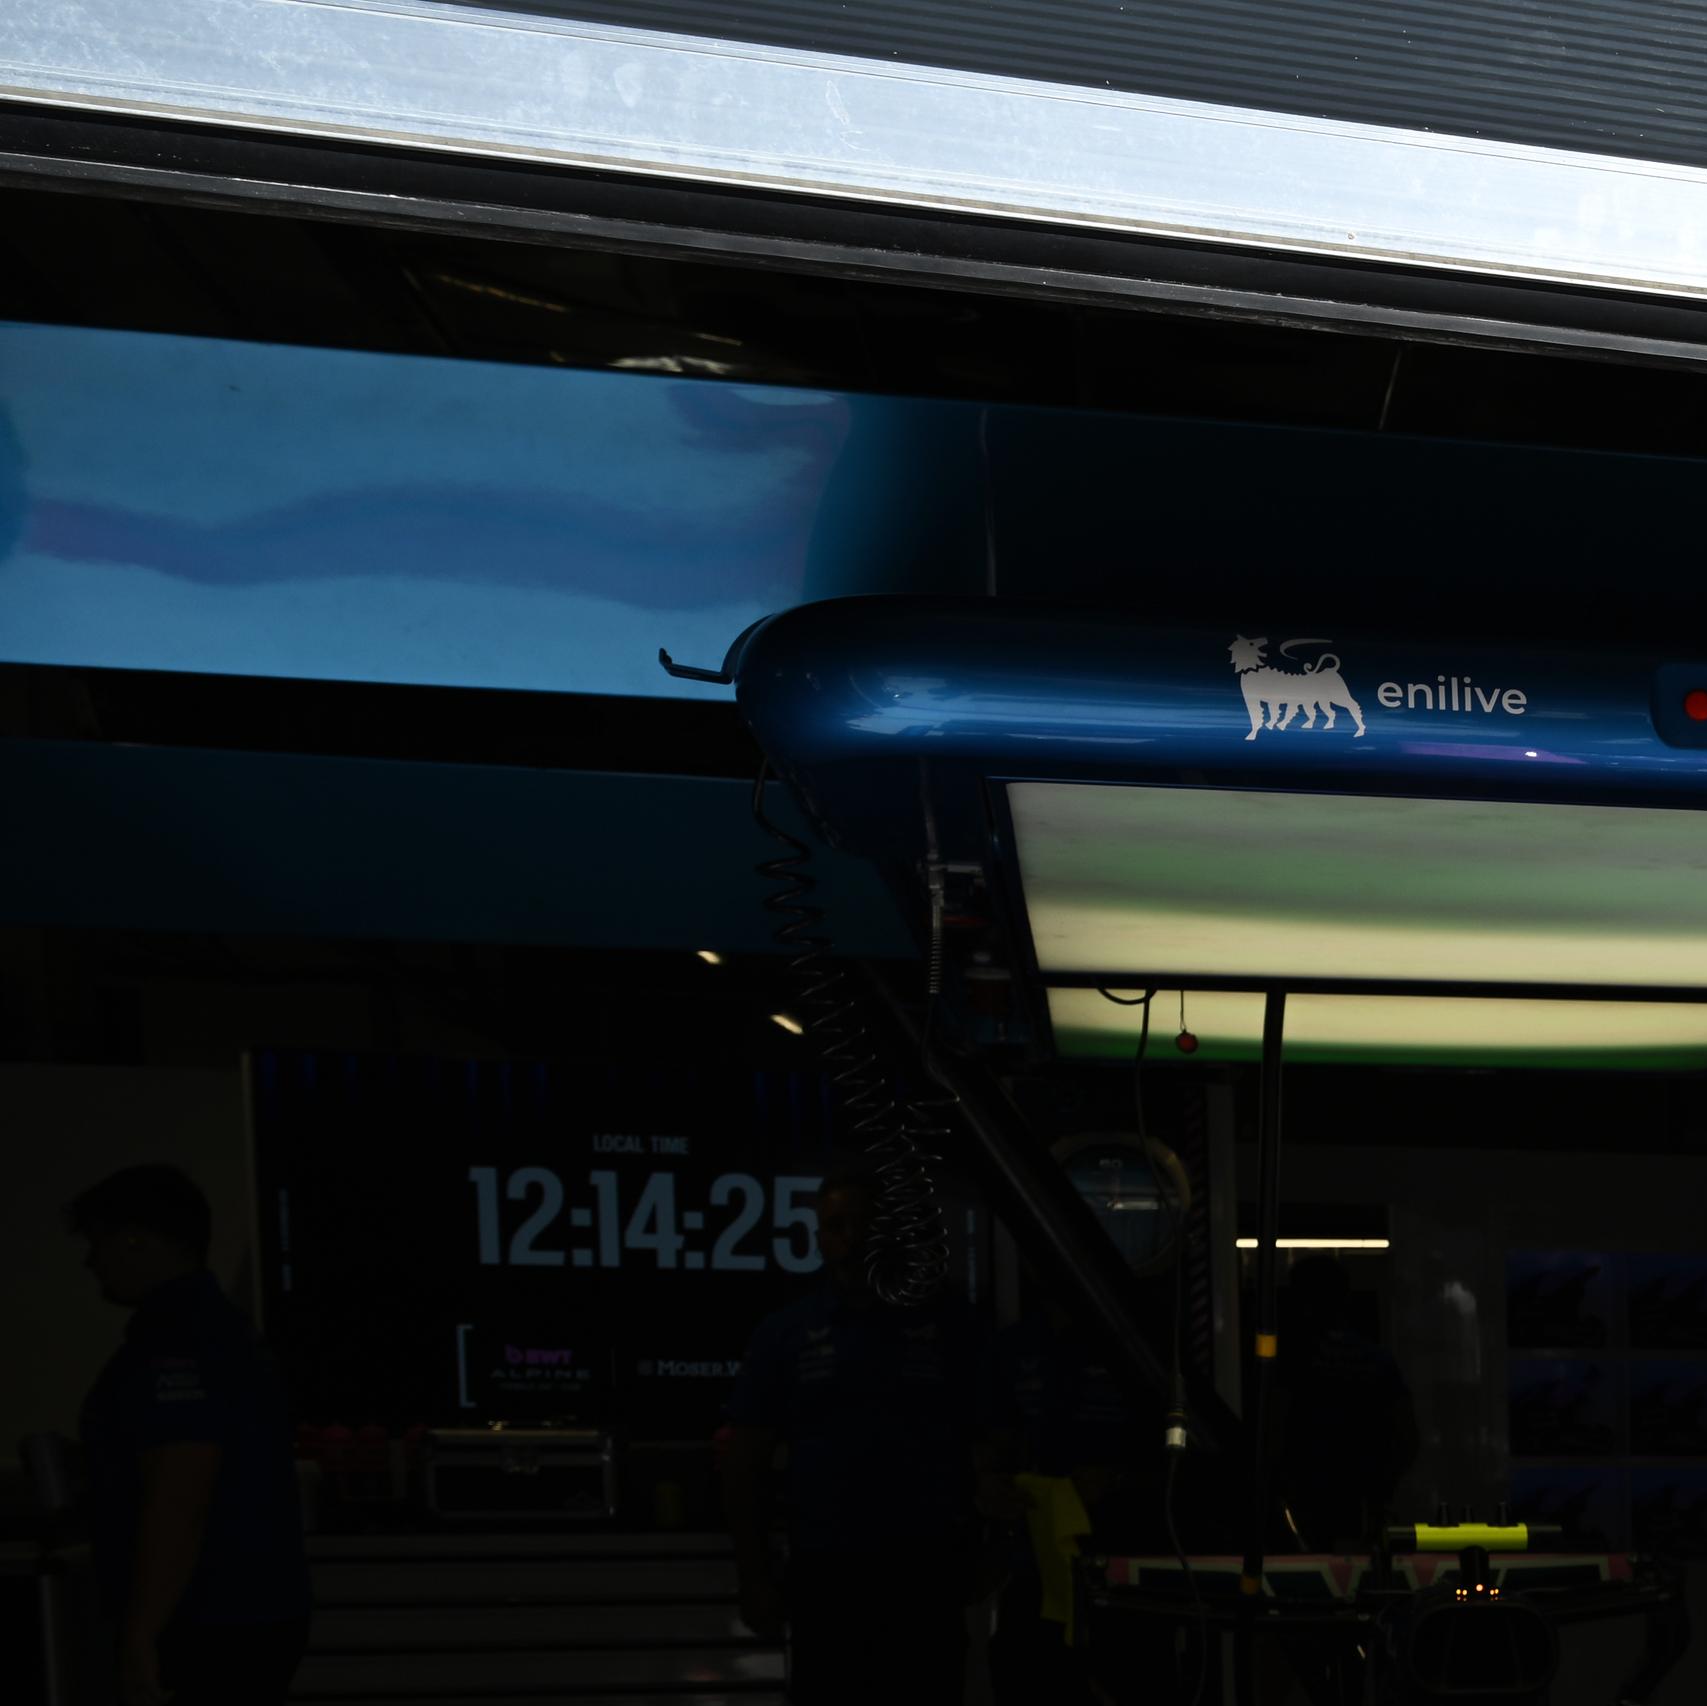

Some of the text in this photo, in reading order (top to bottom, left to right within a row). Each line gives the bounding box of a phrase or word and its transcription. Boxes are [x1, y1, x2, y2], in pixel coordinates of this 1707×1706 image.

[1376, 675, 1527, 717] enilive
[592, 1133, 689, 1154] LOCAL TIME
[468, 1165, 824, 1274] 12:14:25
